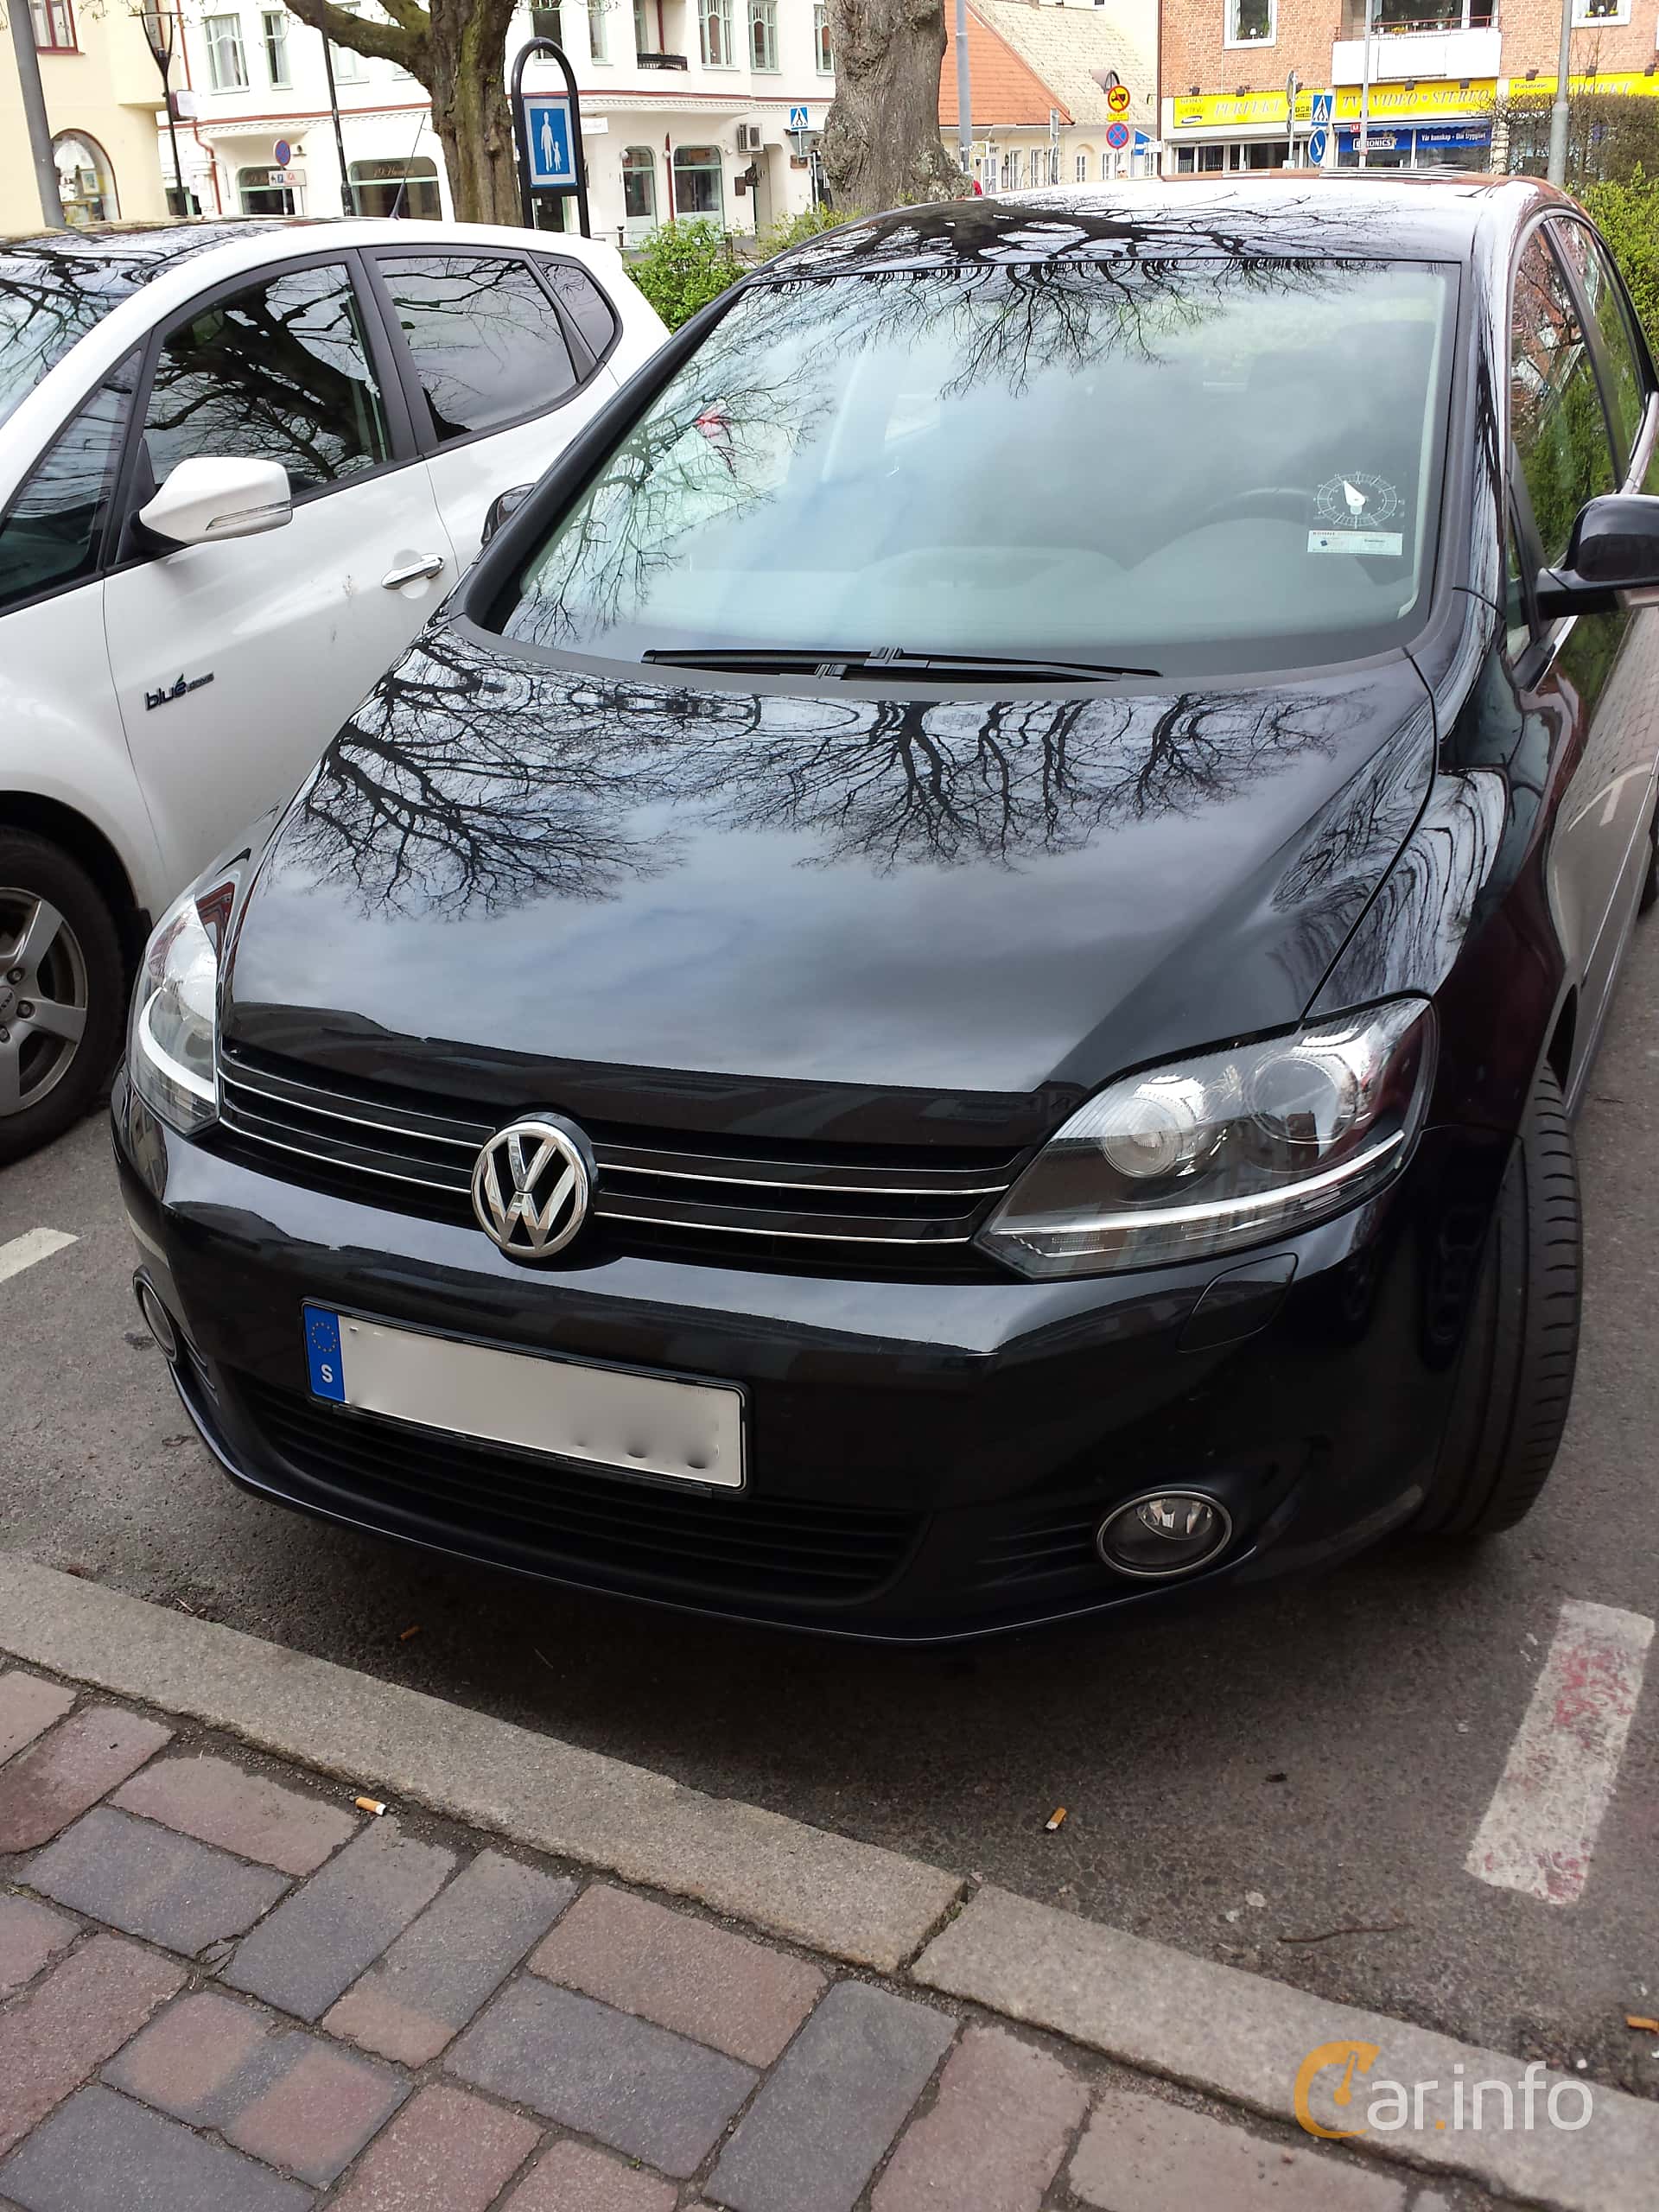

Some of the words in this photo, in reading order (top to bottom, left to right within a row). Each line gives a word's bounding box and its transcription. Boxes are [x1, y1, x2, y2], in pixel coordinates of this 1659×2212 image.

[1214, 99, 1282, 118] PERFEKT
[1342, 96, 1358, 109] TV
[1371, 92, 1418, 107] VIDEO
[1431, 89, 1490, 105] STEREO
[321, 1363, 334, 1383] S
